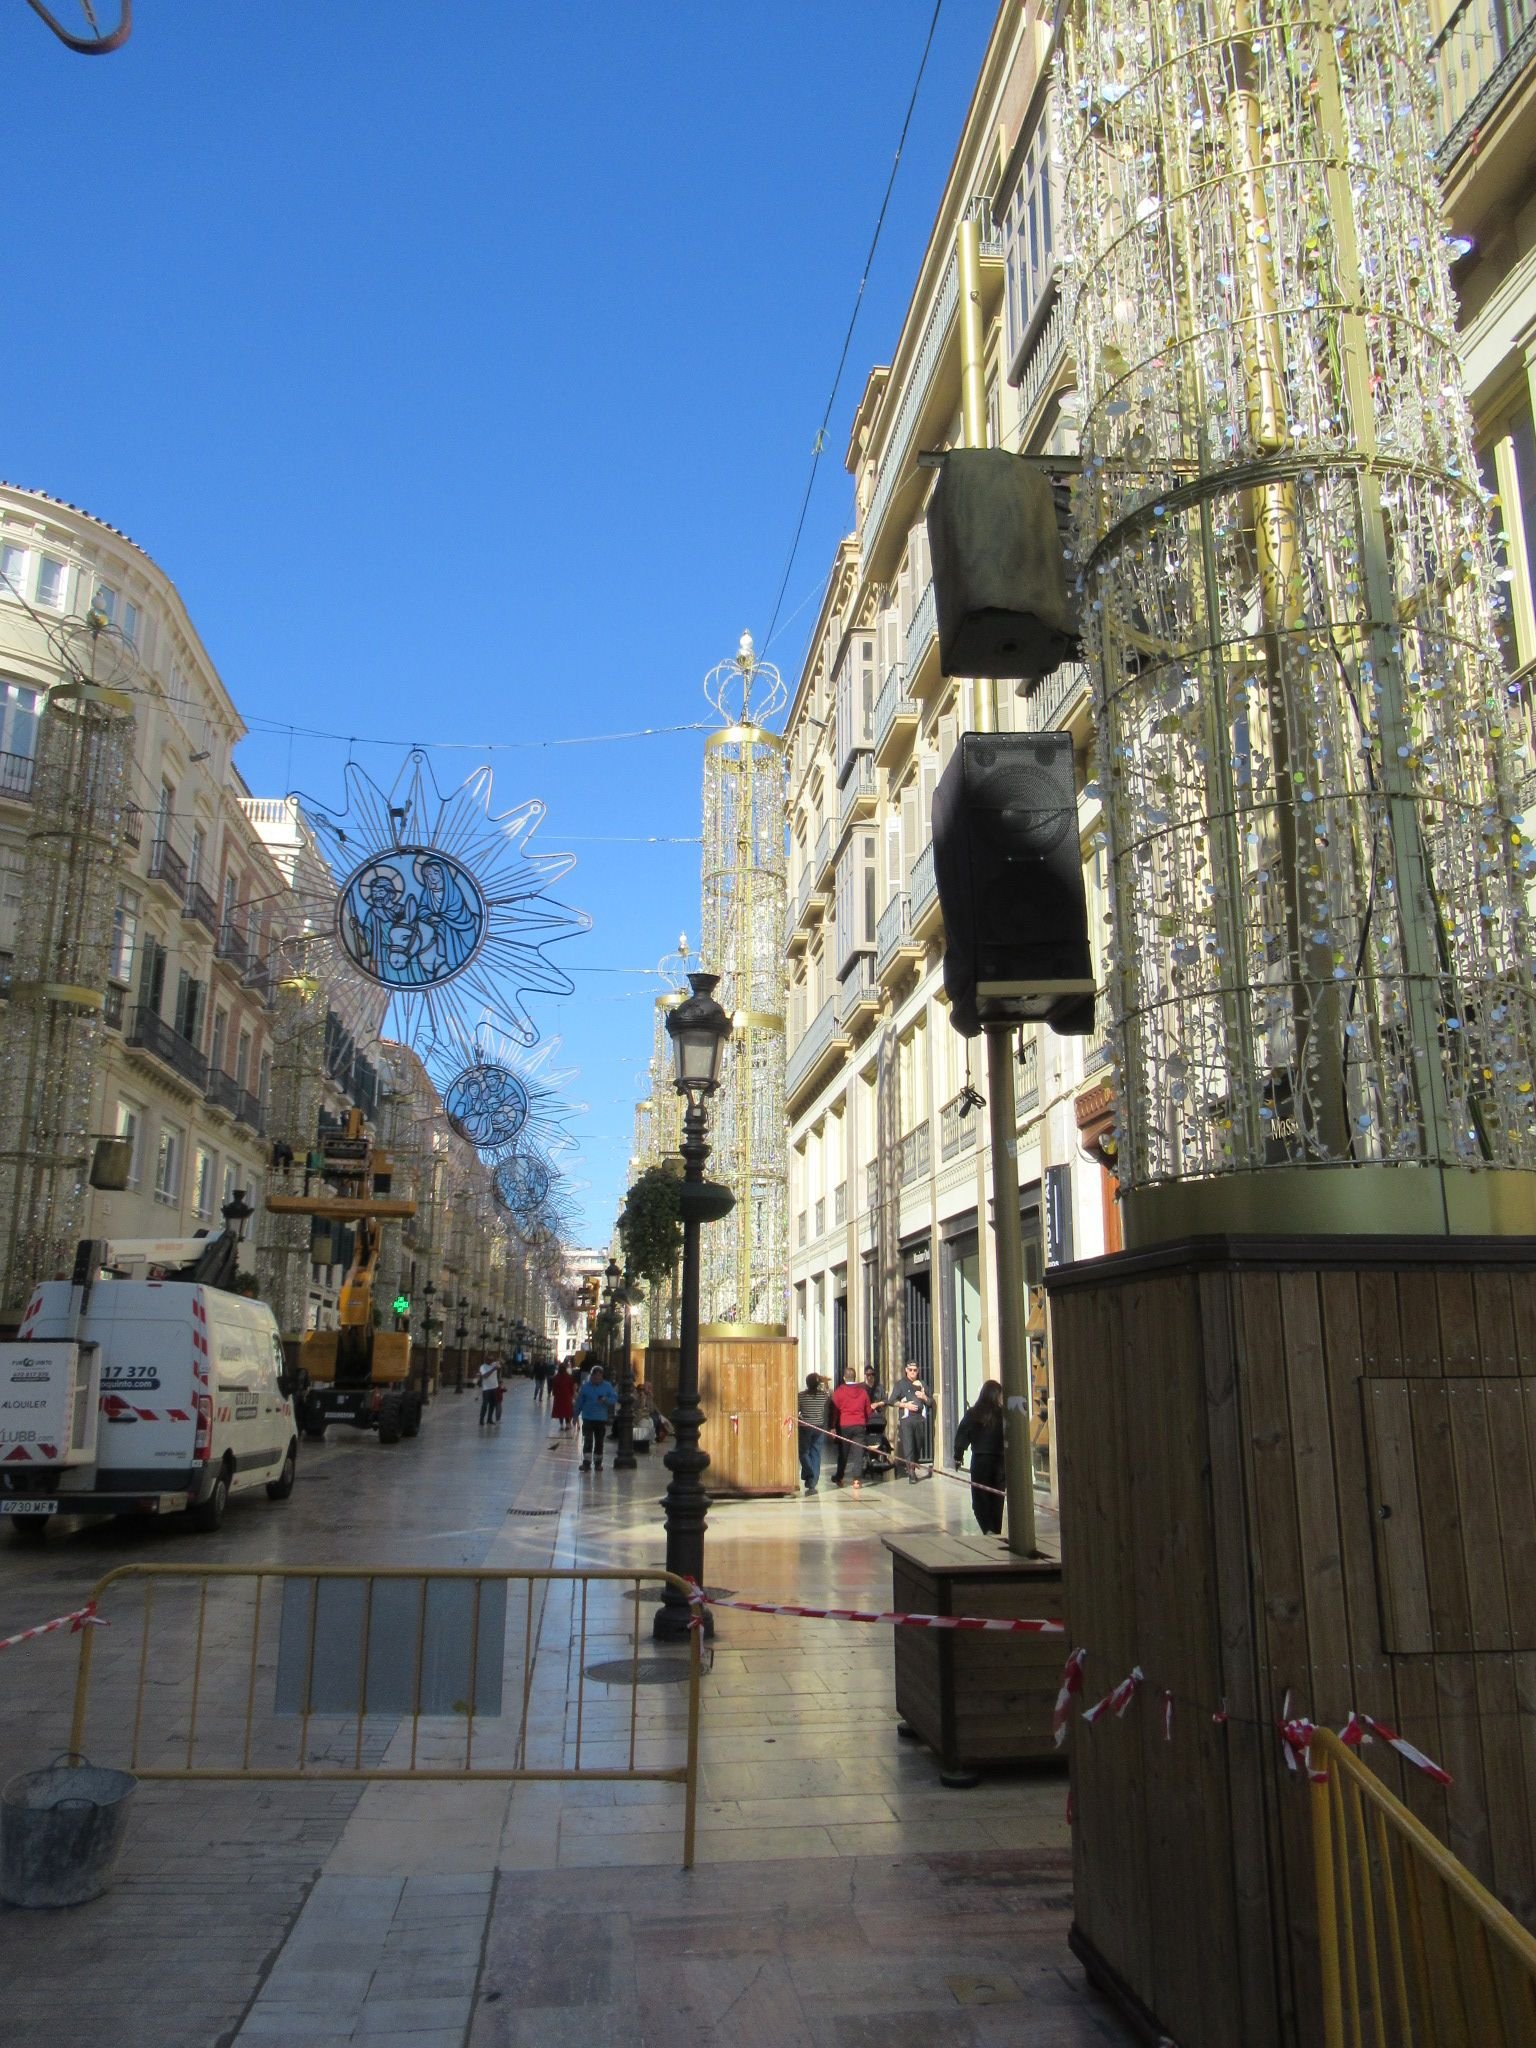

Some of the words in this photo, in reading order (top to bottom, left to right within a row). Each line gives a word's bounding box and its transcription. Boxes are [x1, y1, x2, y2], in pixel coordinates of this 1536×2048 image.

[101, 1366, 122, 1377] 17
[127, 1366, 157, 1377] 370
[1, 1400, 47, 1409] ALQUILER
